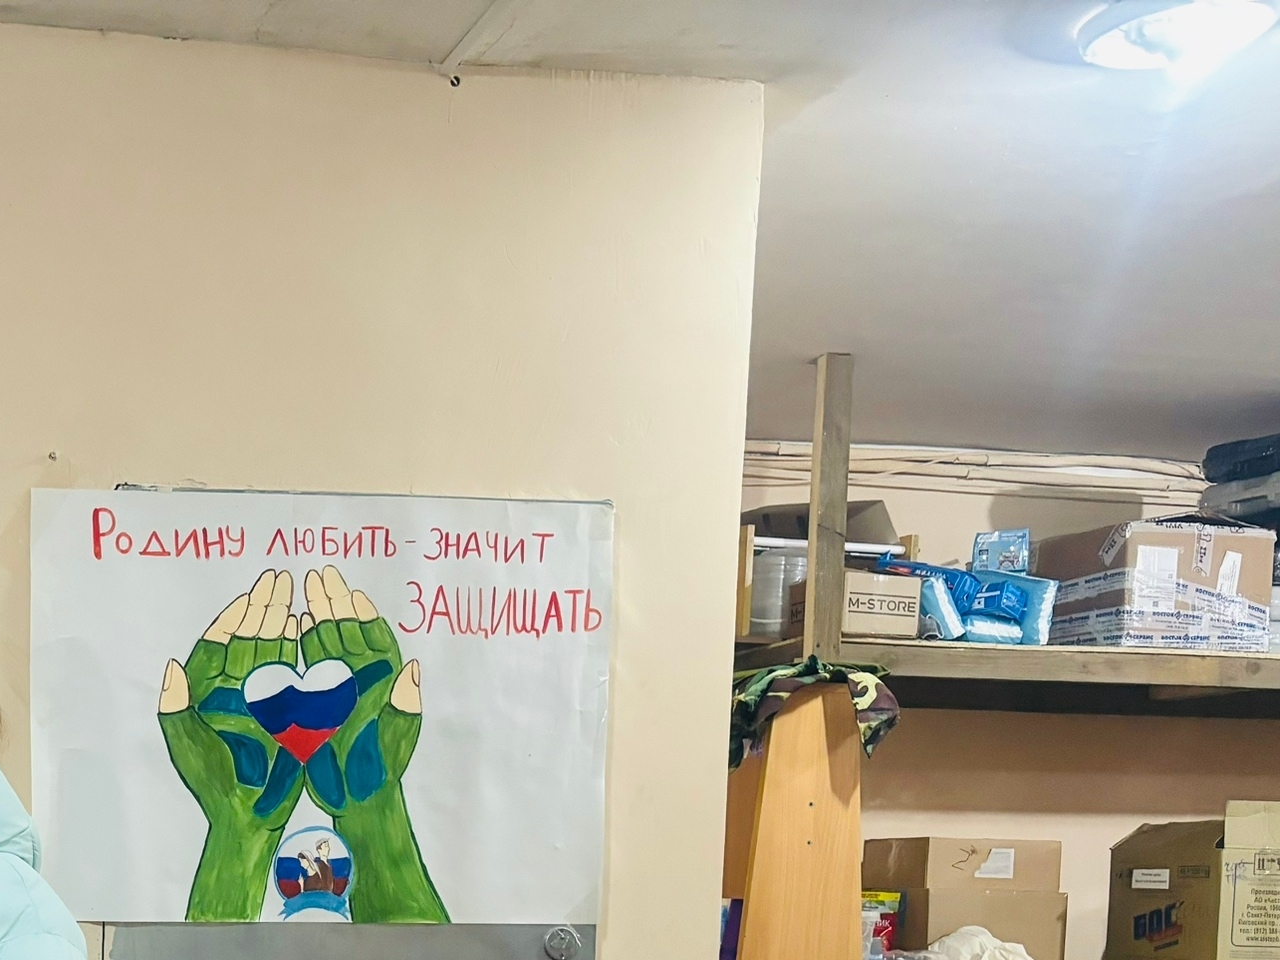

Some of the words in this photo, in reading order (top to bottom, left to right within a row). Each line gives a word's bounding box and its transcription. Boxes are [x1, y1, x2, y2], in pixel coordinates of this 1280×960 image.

[1195, 587, 1215, 598] ВОСТОК
[399, 580, 603, 640] ЗАЩИЩАТЬ
[848, 597, 916, 613] M-STORE
[1247, 911, 1280, 920] Санкт-Петер
